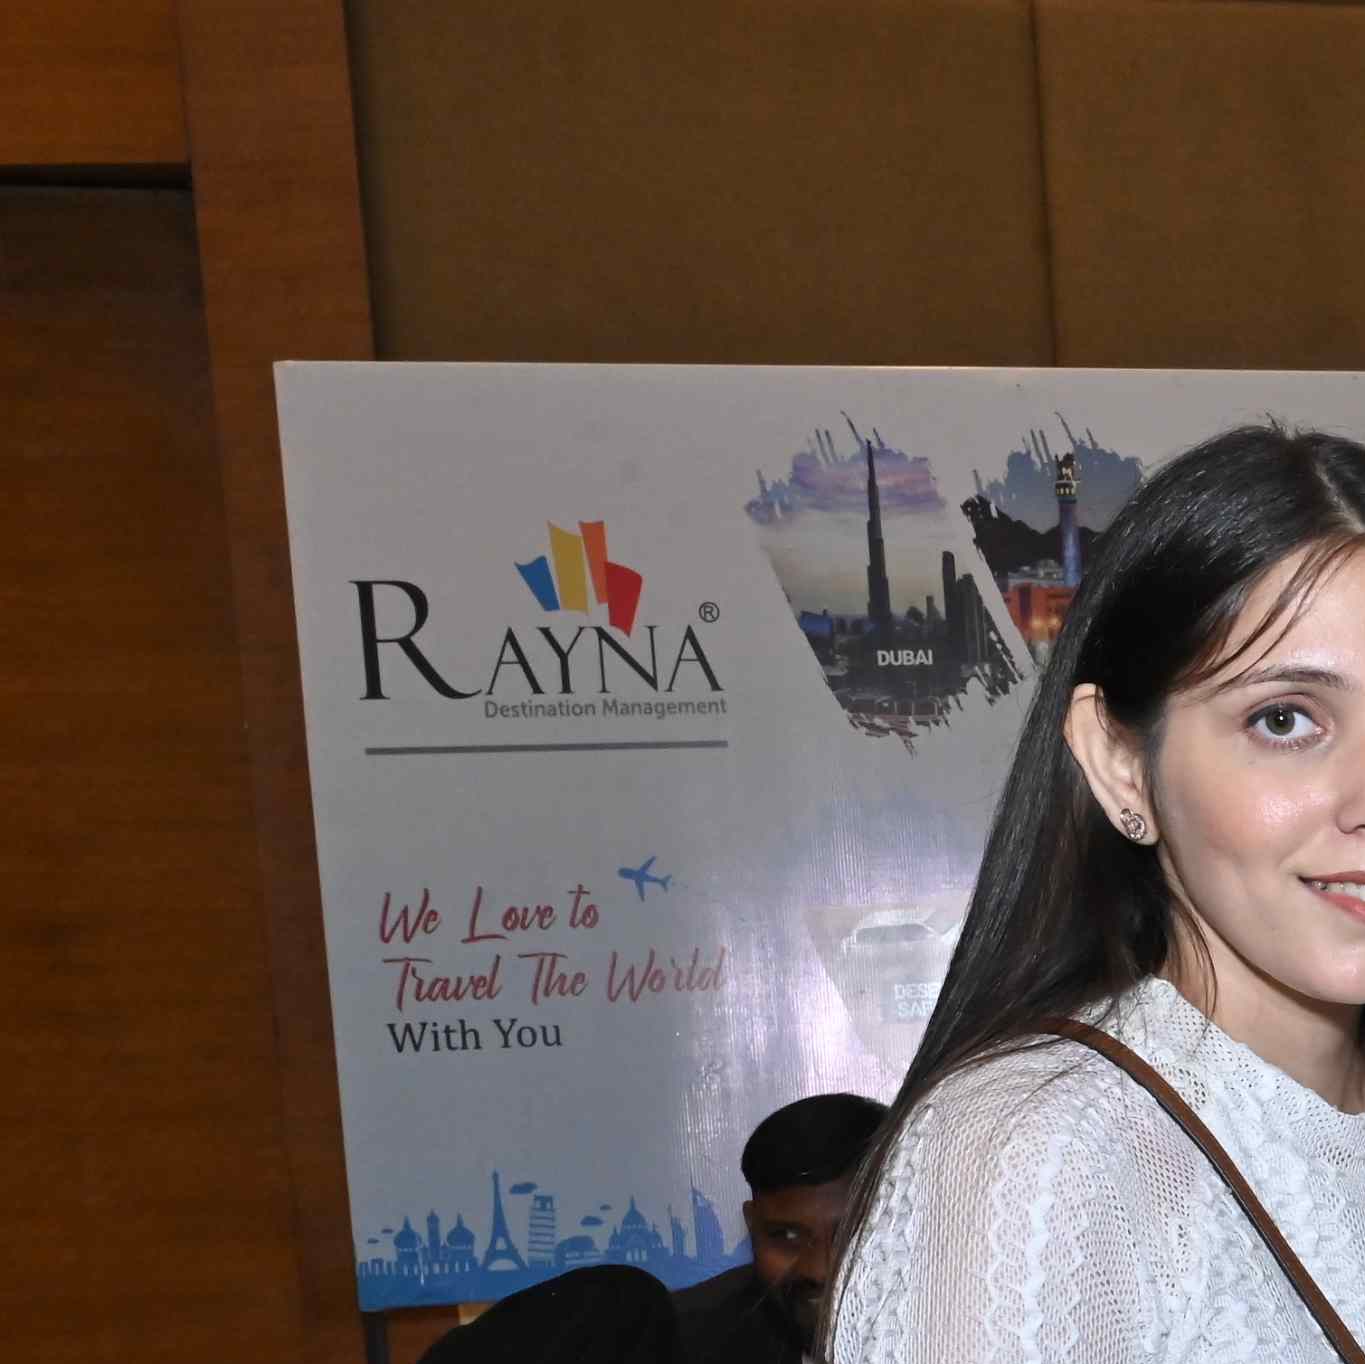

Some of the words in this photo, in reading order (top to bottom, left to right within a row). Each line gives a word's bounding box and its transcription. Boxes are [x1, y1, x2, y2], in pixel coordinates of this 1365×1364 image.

[877, 649, 934, 668] DUBAI
[484, 699, 596, 720] Destination
[601, 697, 728, 721] Management
[379, 887, 441, 945] We
[461, 885, 558, 943] Love
[569, 884, 600, 931] to
[382, 956, 502, 1011] Travel
[518, 951, 589, 1005] The
[607, 946, 728, 1003] World
[894, 981, 942, 1001] DESE
[387, 1017, 482, 1055] With
[493, 1018, 564, 1051] You
